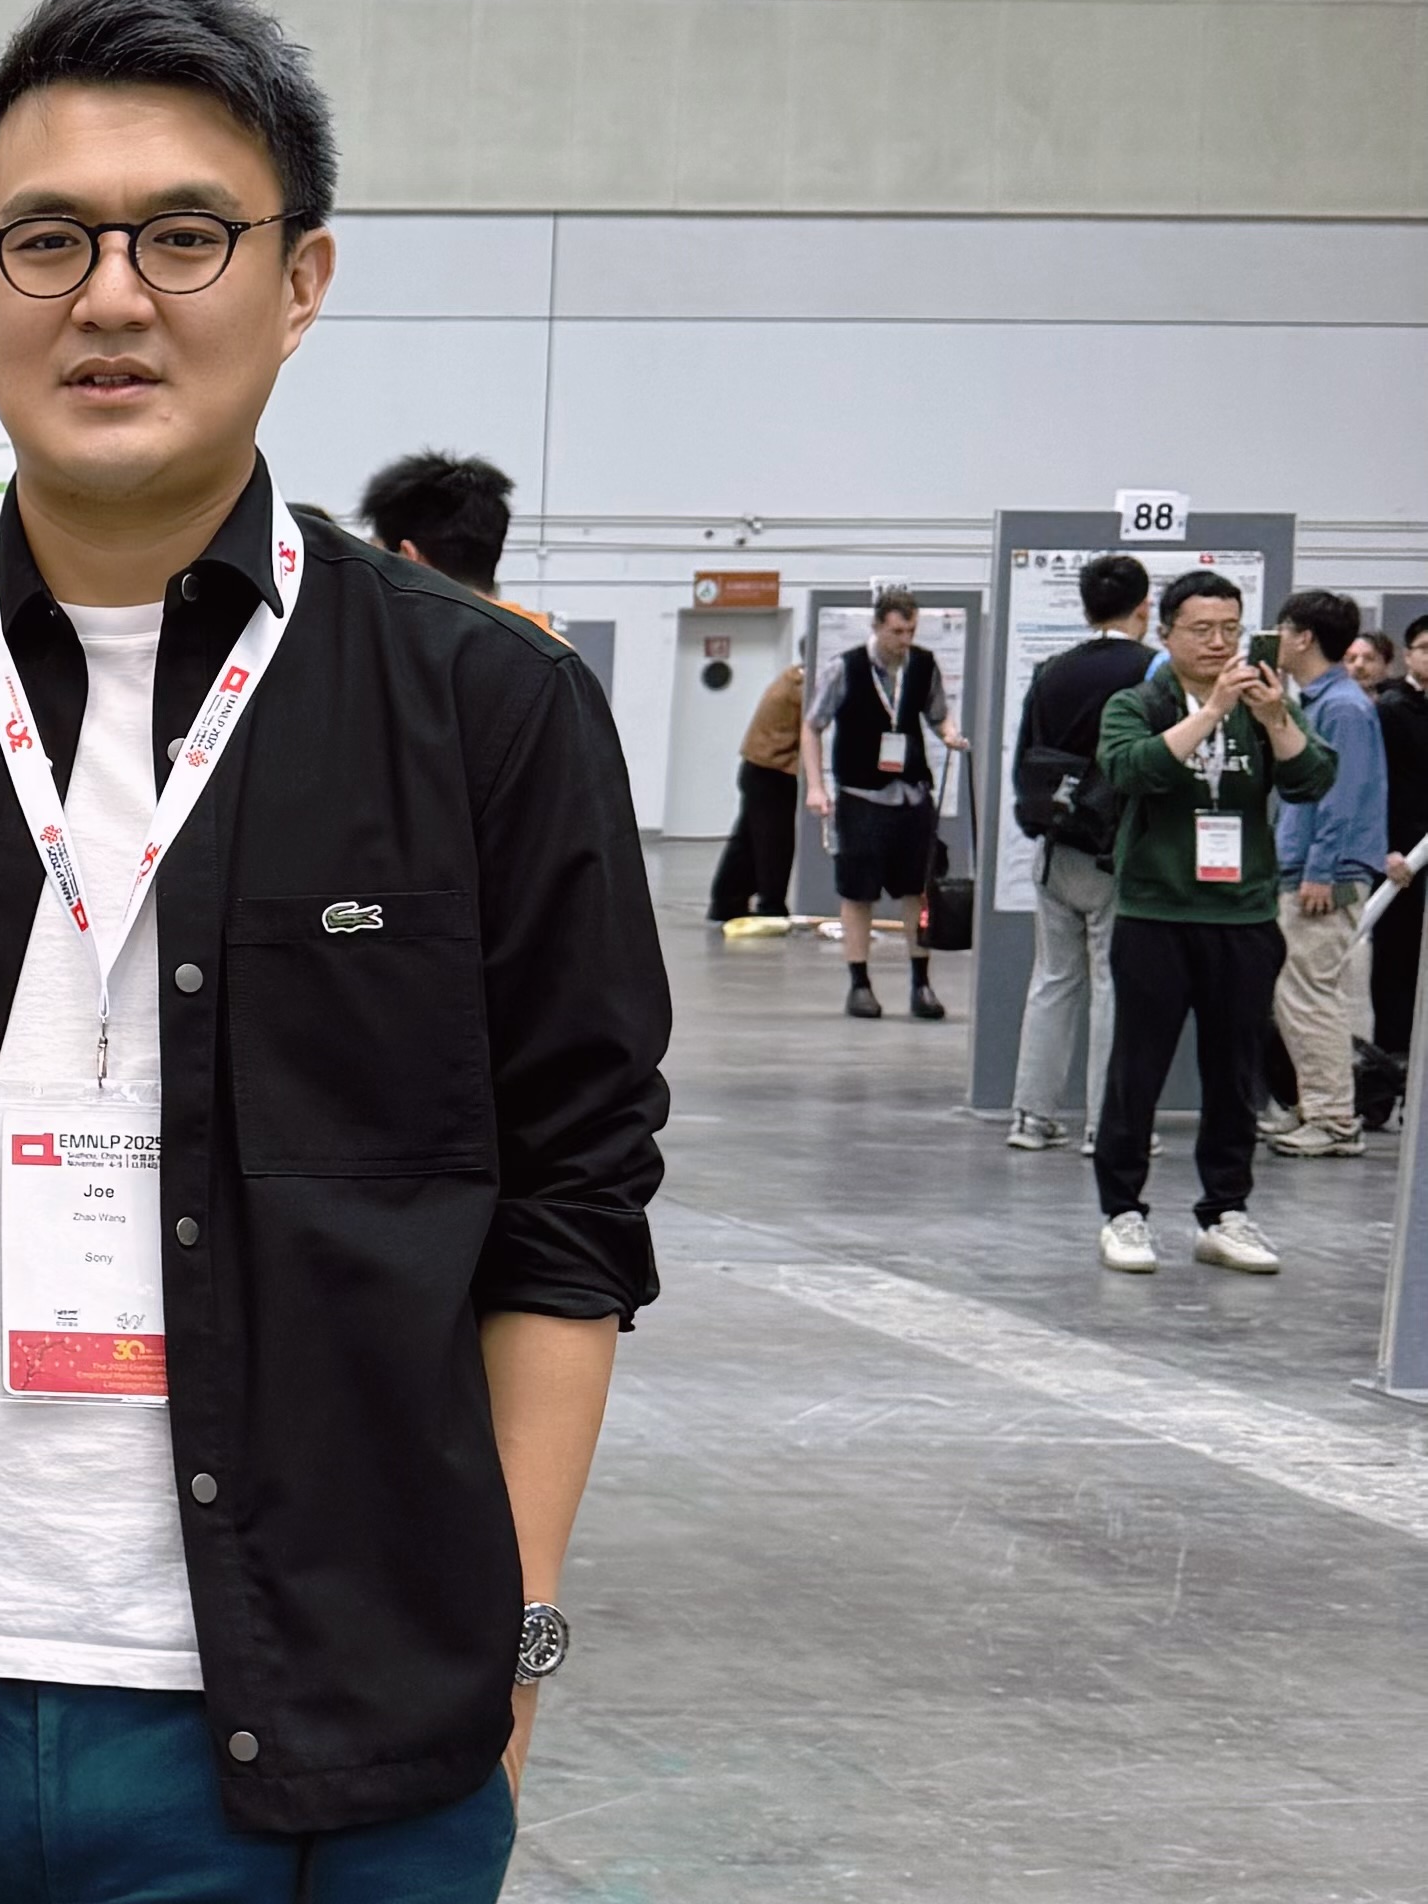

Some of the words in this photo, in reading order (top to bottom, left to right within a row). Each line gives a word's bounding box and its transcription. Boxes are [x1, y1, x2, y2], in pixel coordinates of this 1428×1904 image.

[1133, 502, 1174, 531] 88
[59, 1133, 121, 1149] EMNLP
[83, 1183, 115, 1198] Joe
[73, 1212, 97, 1222] Zhao
[98, 1213, 127, 1224] Wang
[84, 1252, 114, 1265] Sony
